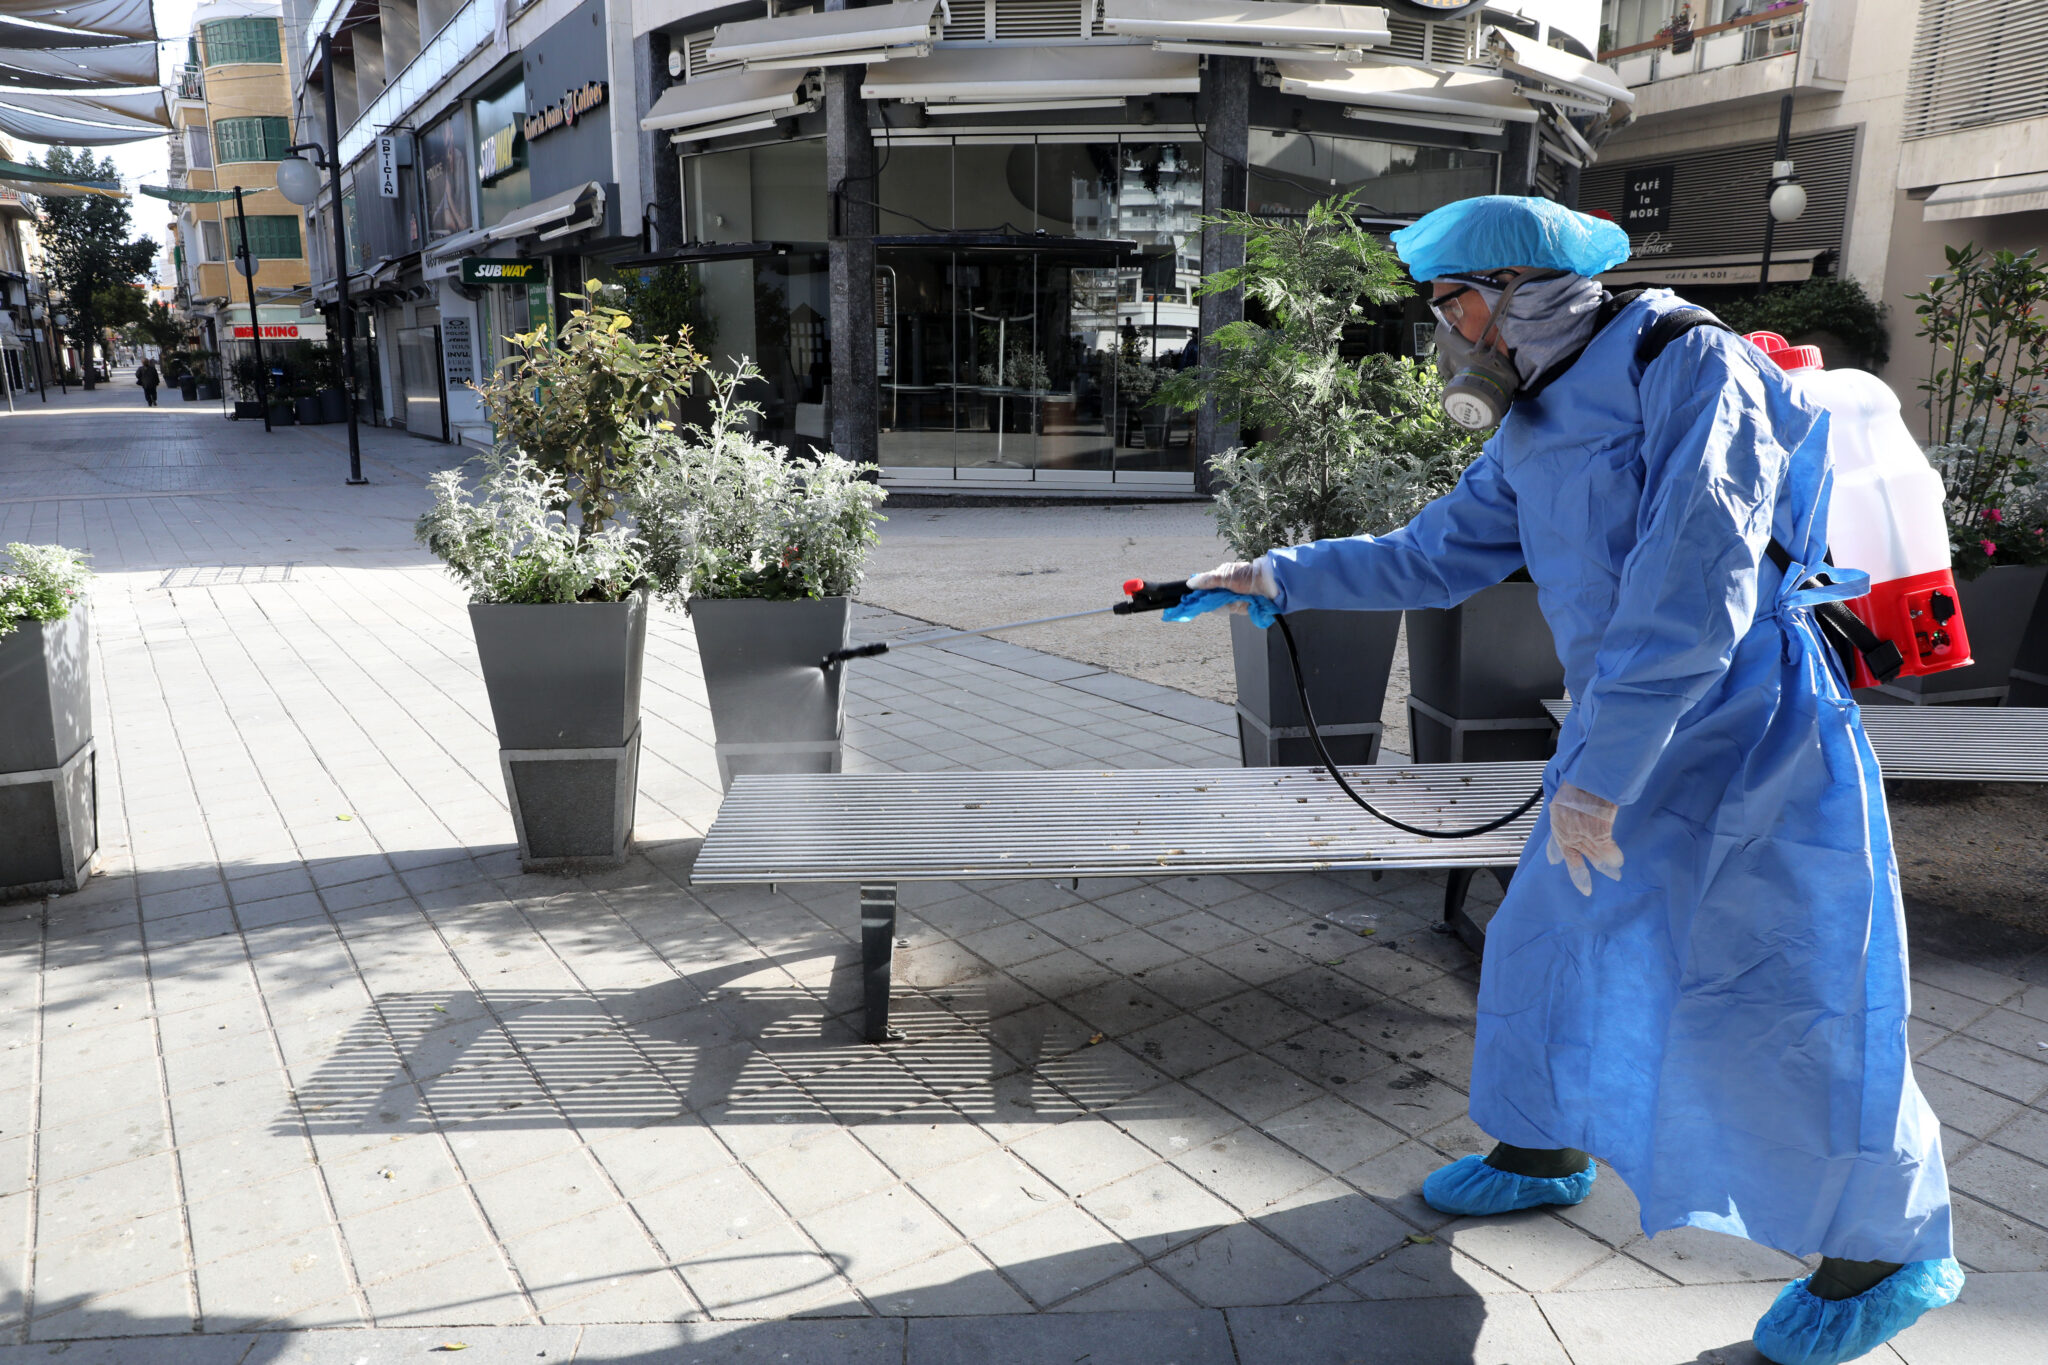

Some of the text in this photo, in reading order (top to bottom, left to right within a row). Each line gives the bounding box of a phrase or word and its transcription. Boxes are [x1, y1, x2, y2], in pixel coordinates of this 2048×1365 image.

[524, 113, 545, 142] Gloria
[572, 82, 603, 112] Coffees
[479, 120, 517, 180] SUBWAY
[382, 139, 394, 194] OPTICIAN
[426, 162, 442, 181] POLICE
[1634, 178, 1660, 191] CAFÉ
[1640, 195, 1650, 204] la
[1629, 208, 1660, 219] MODE
[475, 264, 532, 277] SUBWAY
[1702, 271, 1727, 279] MODE
[264, 326, 298, 337] KING
[449, 376, 472, 385] FILA
